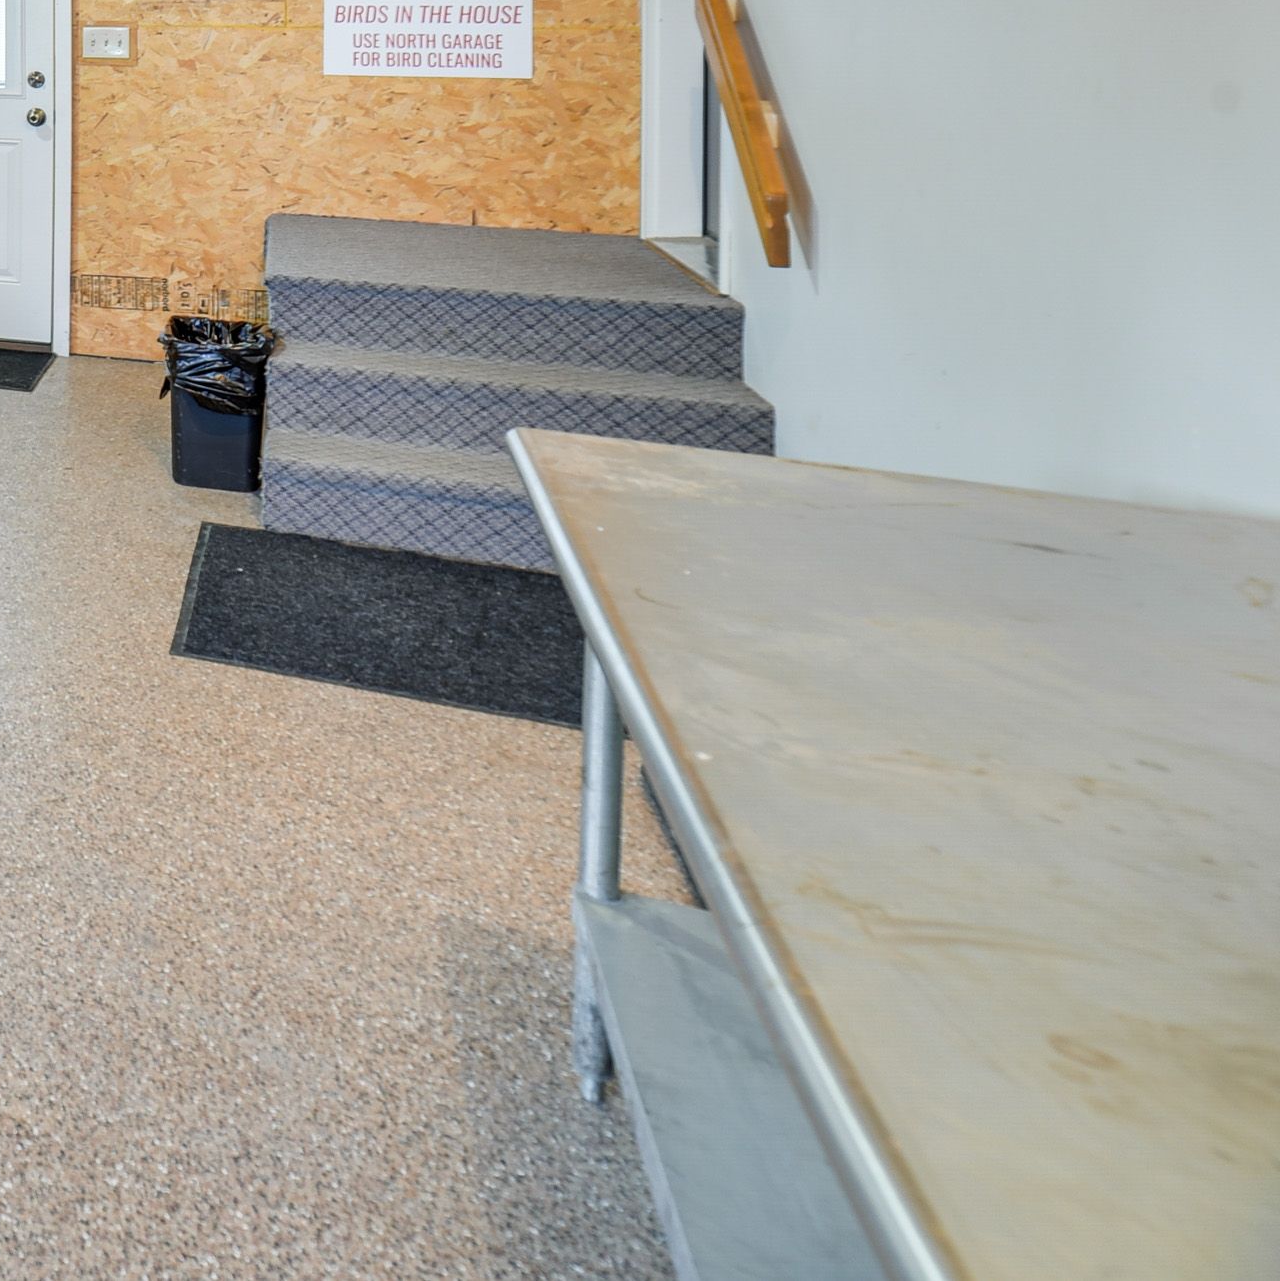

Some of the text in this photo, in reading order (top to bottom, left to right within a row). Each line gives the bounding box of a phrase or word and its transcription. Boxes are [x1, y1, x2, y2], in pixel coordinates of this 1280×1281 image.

[334, 4, 523, 24] BIRDS IN THE HOUSE
[352, 33, 504, 50] USE NORTH GARAGE
[352, 51, 503, 69] FOR BIRD CLEANING
